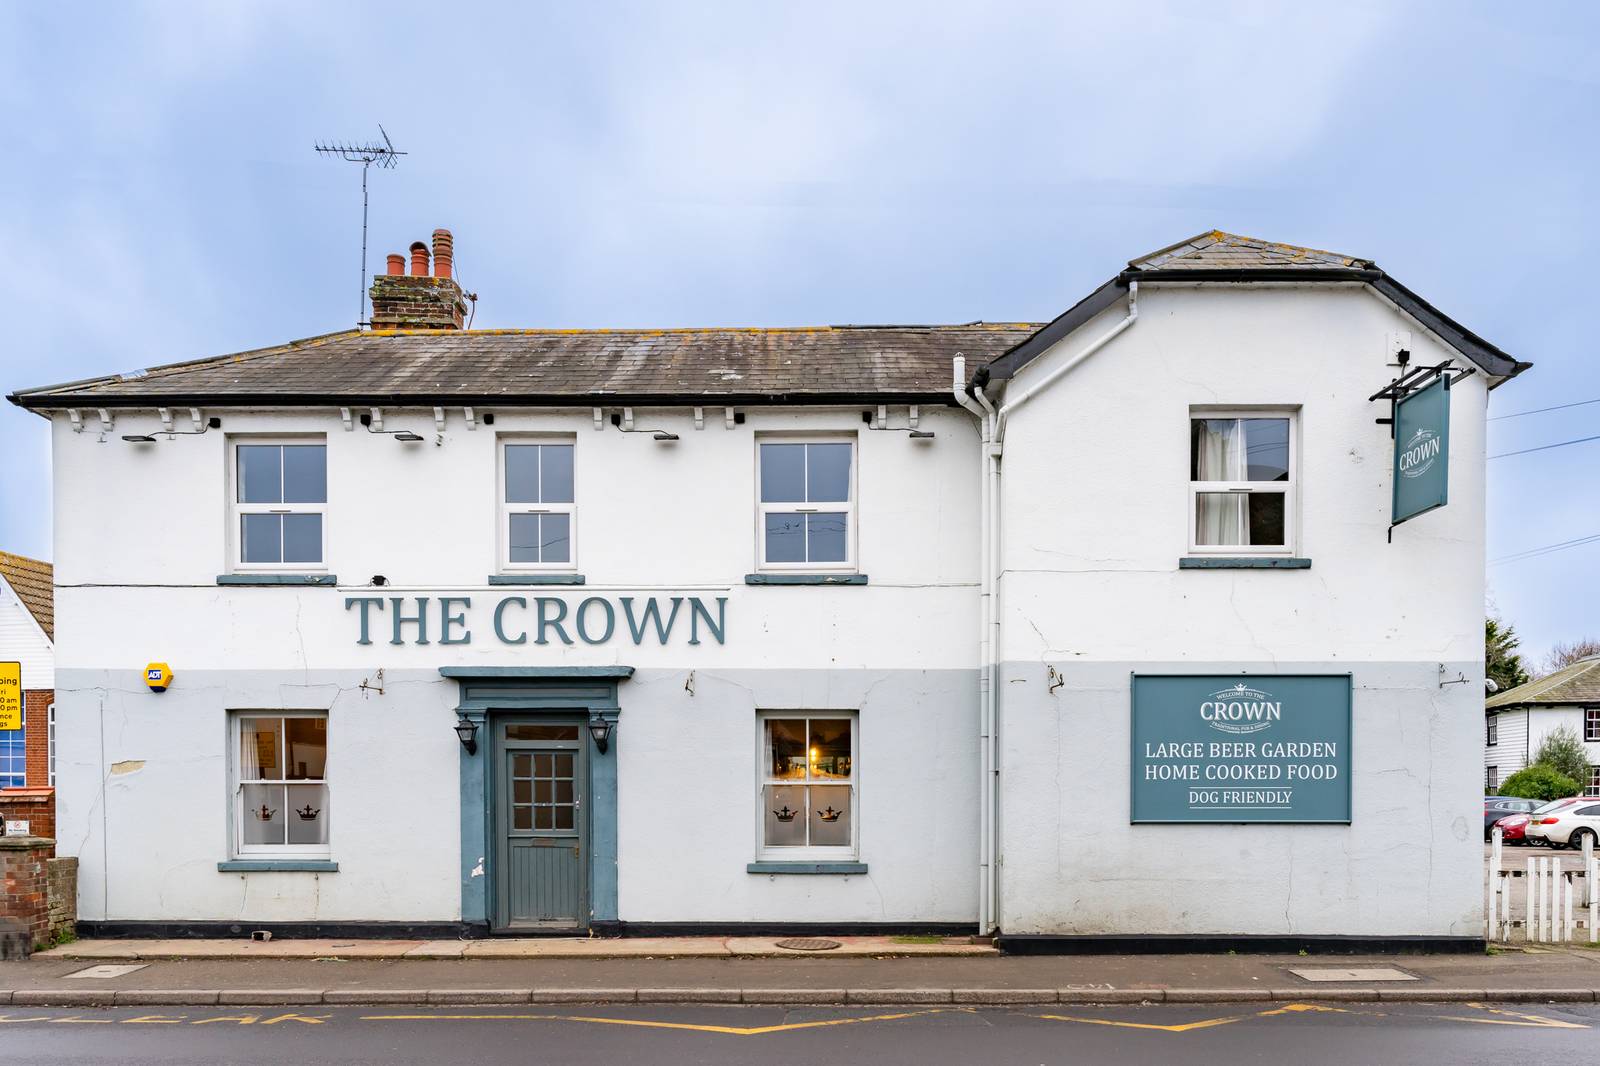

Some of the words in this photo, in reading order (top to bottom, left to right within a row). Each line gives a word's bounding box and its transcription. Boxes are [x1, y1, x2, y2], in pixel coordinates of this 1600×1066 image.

[1400, 436, 1440, 471] CROWN
[345, 597, 471, 645] THE
[494, 596, 729, 645] CROWN
[149, 671, 161, 679] ADT
[1216, 691, 1244, 700] WELCOME
[1254, 692, 1265, 700] THE
[1200, 701, 1282, 721] CROWN
[1145, 742, 1204, 758] LARGE
[1209, 742, 1257, 758] BEER
[1261, 742, 1337, 758] GARDEN
[1145, 764, 1200, 780] HOME
[1205, 764, 1281, 780] COOKED
[1287, 764, 1337, 780] FOOD
[1189, 791, 1219, 804] DOG
[1223, 791, 1292, 804] FRIENDLY
